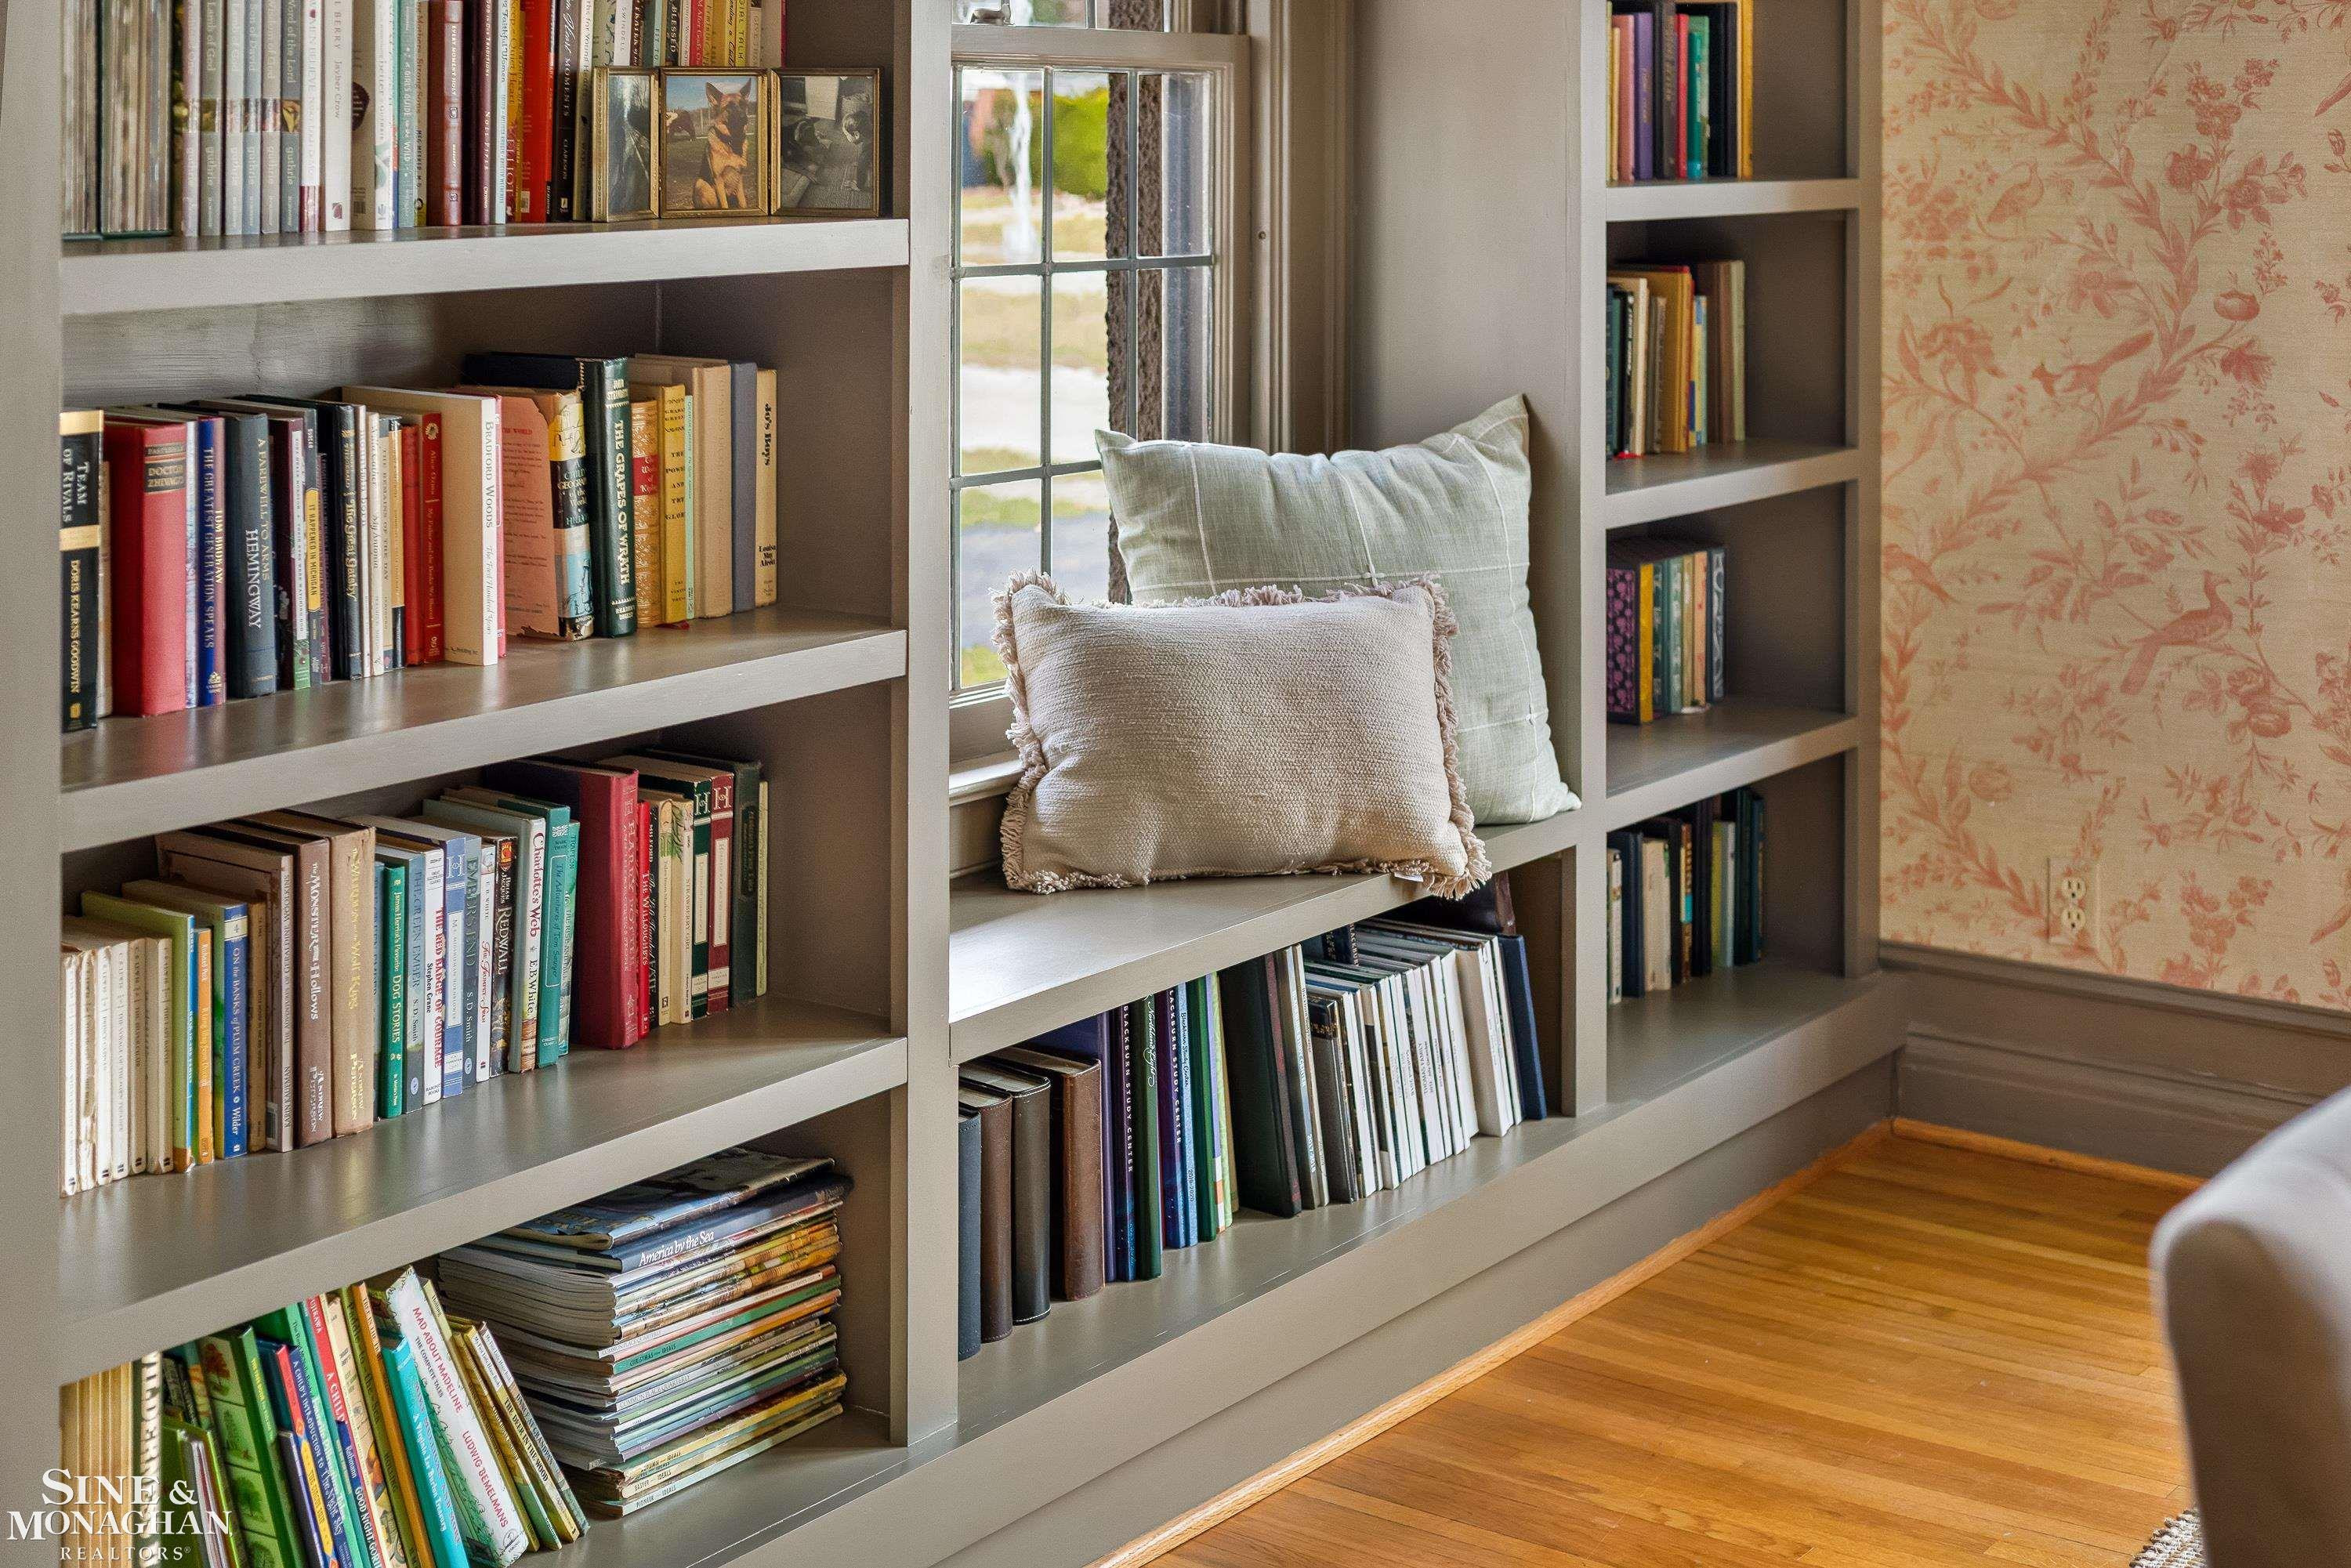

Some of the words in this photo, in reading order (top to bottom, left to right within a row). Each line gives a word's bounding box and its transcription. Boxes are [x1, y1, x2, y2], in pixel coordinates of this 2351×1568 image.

[334, 12, 342, 49] BERRY
[333, 61, 344, 90] Jayber
[333, 94, 344, 118] Crow
[203, 147, 216, 186] guthrie
[283, 147, 296, 186] guthrie
[763, 403, 773, 433] Jo's
[258, 438, 268, 447] A
[484, 421, 495, 481] BRADFORD
[614, 420, 625, 450] THE
[763, 433, 773, 466] Boys
[204, 447, 215, 470] THE
[76, 462, 90, 505] TEAM
[259, 451, 269, 517] FAREWELL
[614, 452, 627, 508] GRAPES
[62, 471, 78, 523] RIVALS
[204, 473, 215, 529] GREATEST
[345, 502, 358, 524] The
[484, 484, 495, 528] WOODS
[260, 520, 270, 540] TO
[309, 513, 317, 550] HAPPENED
[617, 512, 629, 531] OF
[345, 524, 358, 556] Great
[204, 533, 215, 603] GENERATION
[261, 545, 270, 581] ARMS
[484, 561, 494, 578] First
[618, 533, 629, 585] WRATH
[70, 560, 82, 593] DORIS
[245, 529, 262, 628] HEMINGWAY
[310, 561, 318, 596] MICHIGAN
[345, 558, 358, 602] Gatsby
[484, 579, 494, 612] Hundred
[70, 595, 82, 639] KEARNS
[204, 607, 215, 650] SPEAKS
[484, 613, 494, 636] Years
[70, 640, 82, 693] GOODWIN
[532, 832, 547, 904] Charlotte's
[641, 871, 650, 895] THE
[413, 871, 423, 898] THE
[393, 892, 403, 913] James
[553, 879, 564, 923] Adventures
[393, 914, 403, 943] Herriot's
[413, 900, 423, 942] GREEN
[434, 907, 444, 930] THE
[530, 907, 542, 937] Web
[641, 896, 650, 966] WILLOUGHBYS
[201, 944, 209, 966] Richard
[233, 947, 241, 964] ON
[434, 932, 444, 956] RED
[495, 907, 513, 975] REDWALL
[393, 943, 403, 972] Favorite
[413, 945, 423, 989] EMBER
[551, 950, 560, 978] Sawyer
[201, 968, 209, 981] Peck
[393, 974, 403, 1000] DOG
[426, 962, 434, 991] Stephen
[434, 961, 444, 996] BADGE
[426, 992, 434, 1013] Crane
[393, 1001, 403, 1044] STORIES
[411, 1019, 421, 1043] Smith
[465, 1016, 474, 1042] Smith
[1168, 989, 1177, 1051] LACKBURN
[434, 1019, 444, 1068] COURAGE
[1180, 1045, 1189, 1064] Study
[1295, 1032, 1304, 1058] STUDY
[1299, 1059, 1307, 1088] CENTER
[232, 1106, 241, 1135] Wilder
[1306, 1133, 1317, 1172] 2017-2018
[639, 1245, 675, 1267] America
[673, 1240, 686, 1253] by
[686, 1235, 700, 1250] the
[700, 1230, 715, 1245] Sea
[412, 1307, 426, 1331] MAD
[422, 1330, 442, 1367] ABOUT
[437, 1365, 464, 1414] MADELINE
[415, 1335, 424, 1350] THE
[420, 1350, 437, 1382] COMPLETE
[433, 1380, 444, 1399] TALES
[629, 1351, 654, 1367] CHRISTMAS
[661, 1343, 676, 1355] IDEALS
[295, 1369, 306, 1397] CHILD'S
[302, 1399, 323, 1457] INTRODUCTION
[416, 1421, 428, 1450] Virginia
[502, 1397, 515, 1414] THE
[509, 1413, 527, 1436] DEER
[524, 1442, 539, 1460] THE
[533, 1458, 550, 1481] WOOD
[343, 1445, 358, 1479] Rathmann
[320, 1471, 331, 1487] The
[428, 1467, 439, 1495] Burton
[462, 1429, 482, 1467] LUDWIG
[478, 1467, 509, 1529] BEMELMANS
[634, 1479, 650, 1491] EASTER
[657, 1470, 672, 1481] IDEALS
[324, 1487, 339, 1515] Night
[635, 1495, 654, 1508] PIONEER
[661, 1484, 676, 1497] IDEALS
[330, 1517, 344, 1535] Sky
[433, 1498, 447, 1531] Treasury
